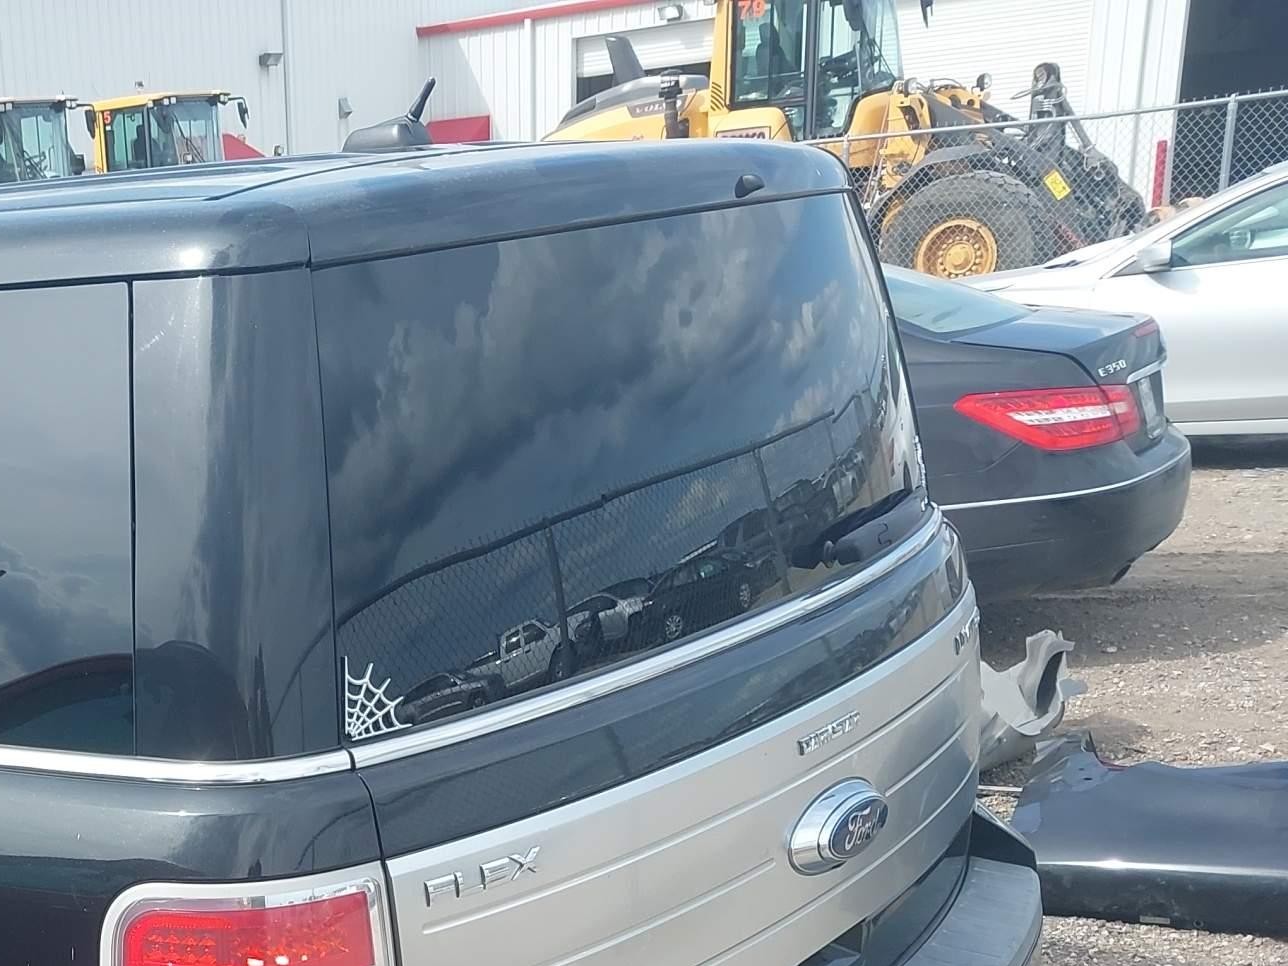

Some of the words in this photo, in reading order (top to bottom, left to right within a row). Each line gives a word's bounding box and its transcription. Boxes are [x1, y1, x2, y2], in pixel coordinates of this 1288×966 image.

[1098, 359, 1127, 377] E350
[844, 805, 883, 851] Ford
[423, 846, 540, 907] FLEX
